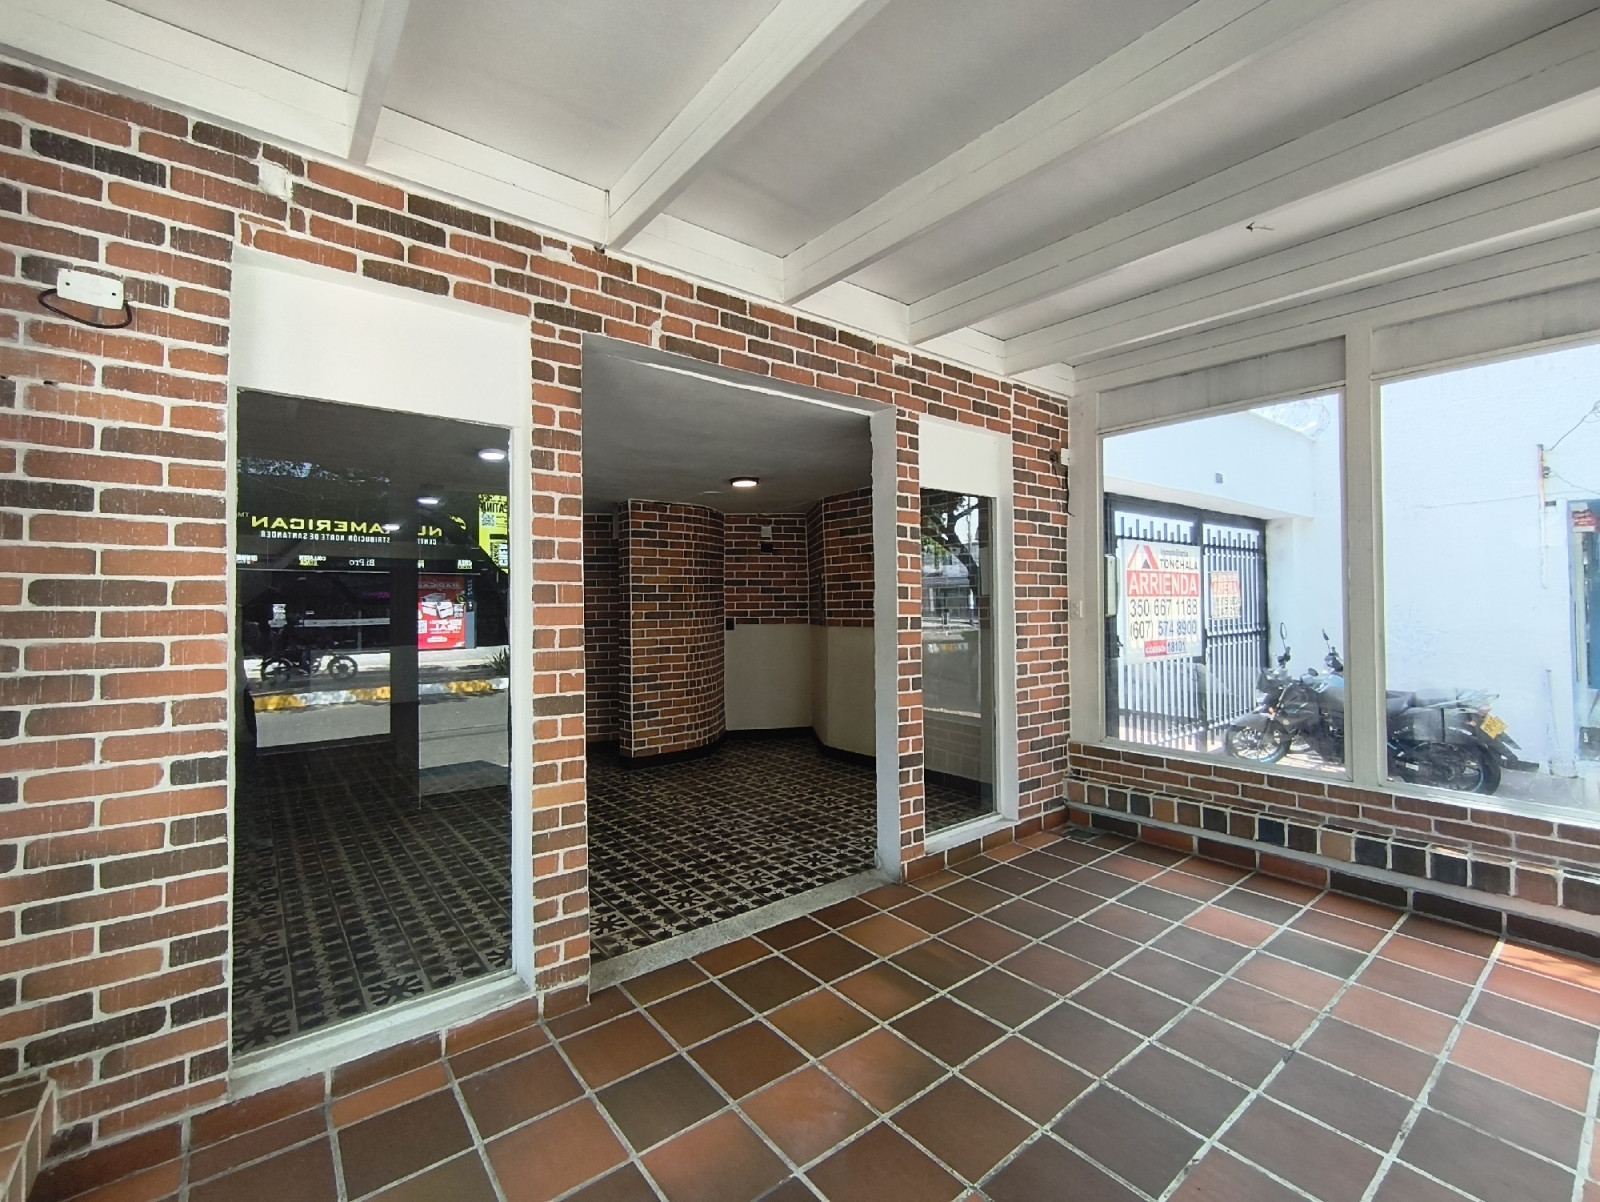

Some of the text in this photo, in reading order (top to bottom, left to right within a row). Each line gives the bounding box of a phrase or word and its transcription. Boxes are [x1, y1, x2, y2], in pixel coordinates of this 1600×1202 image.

[1159, 558, 1198, 570] TONCHALA
[1128, 572, 1197, 595] ARRIENDA
[1130, 598, 1150, 617] 350
[1154, 598, 1172, 616] 667
[1176, 598, 1198, 615] 1188
[1130, 619, 1197, 640] (607) 574 8900
[1168, 640, 1186, 652] 18101
